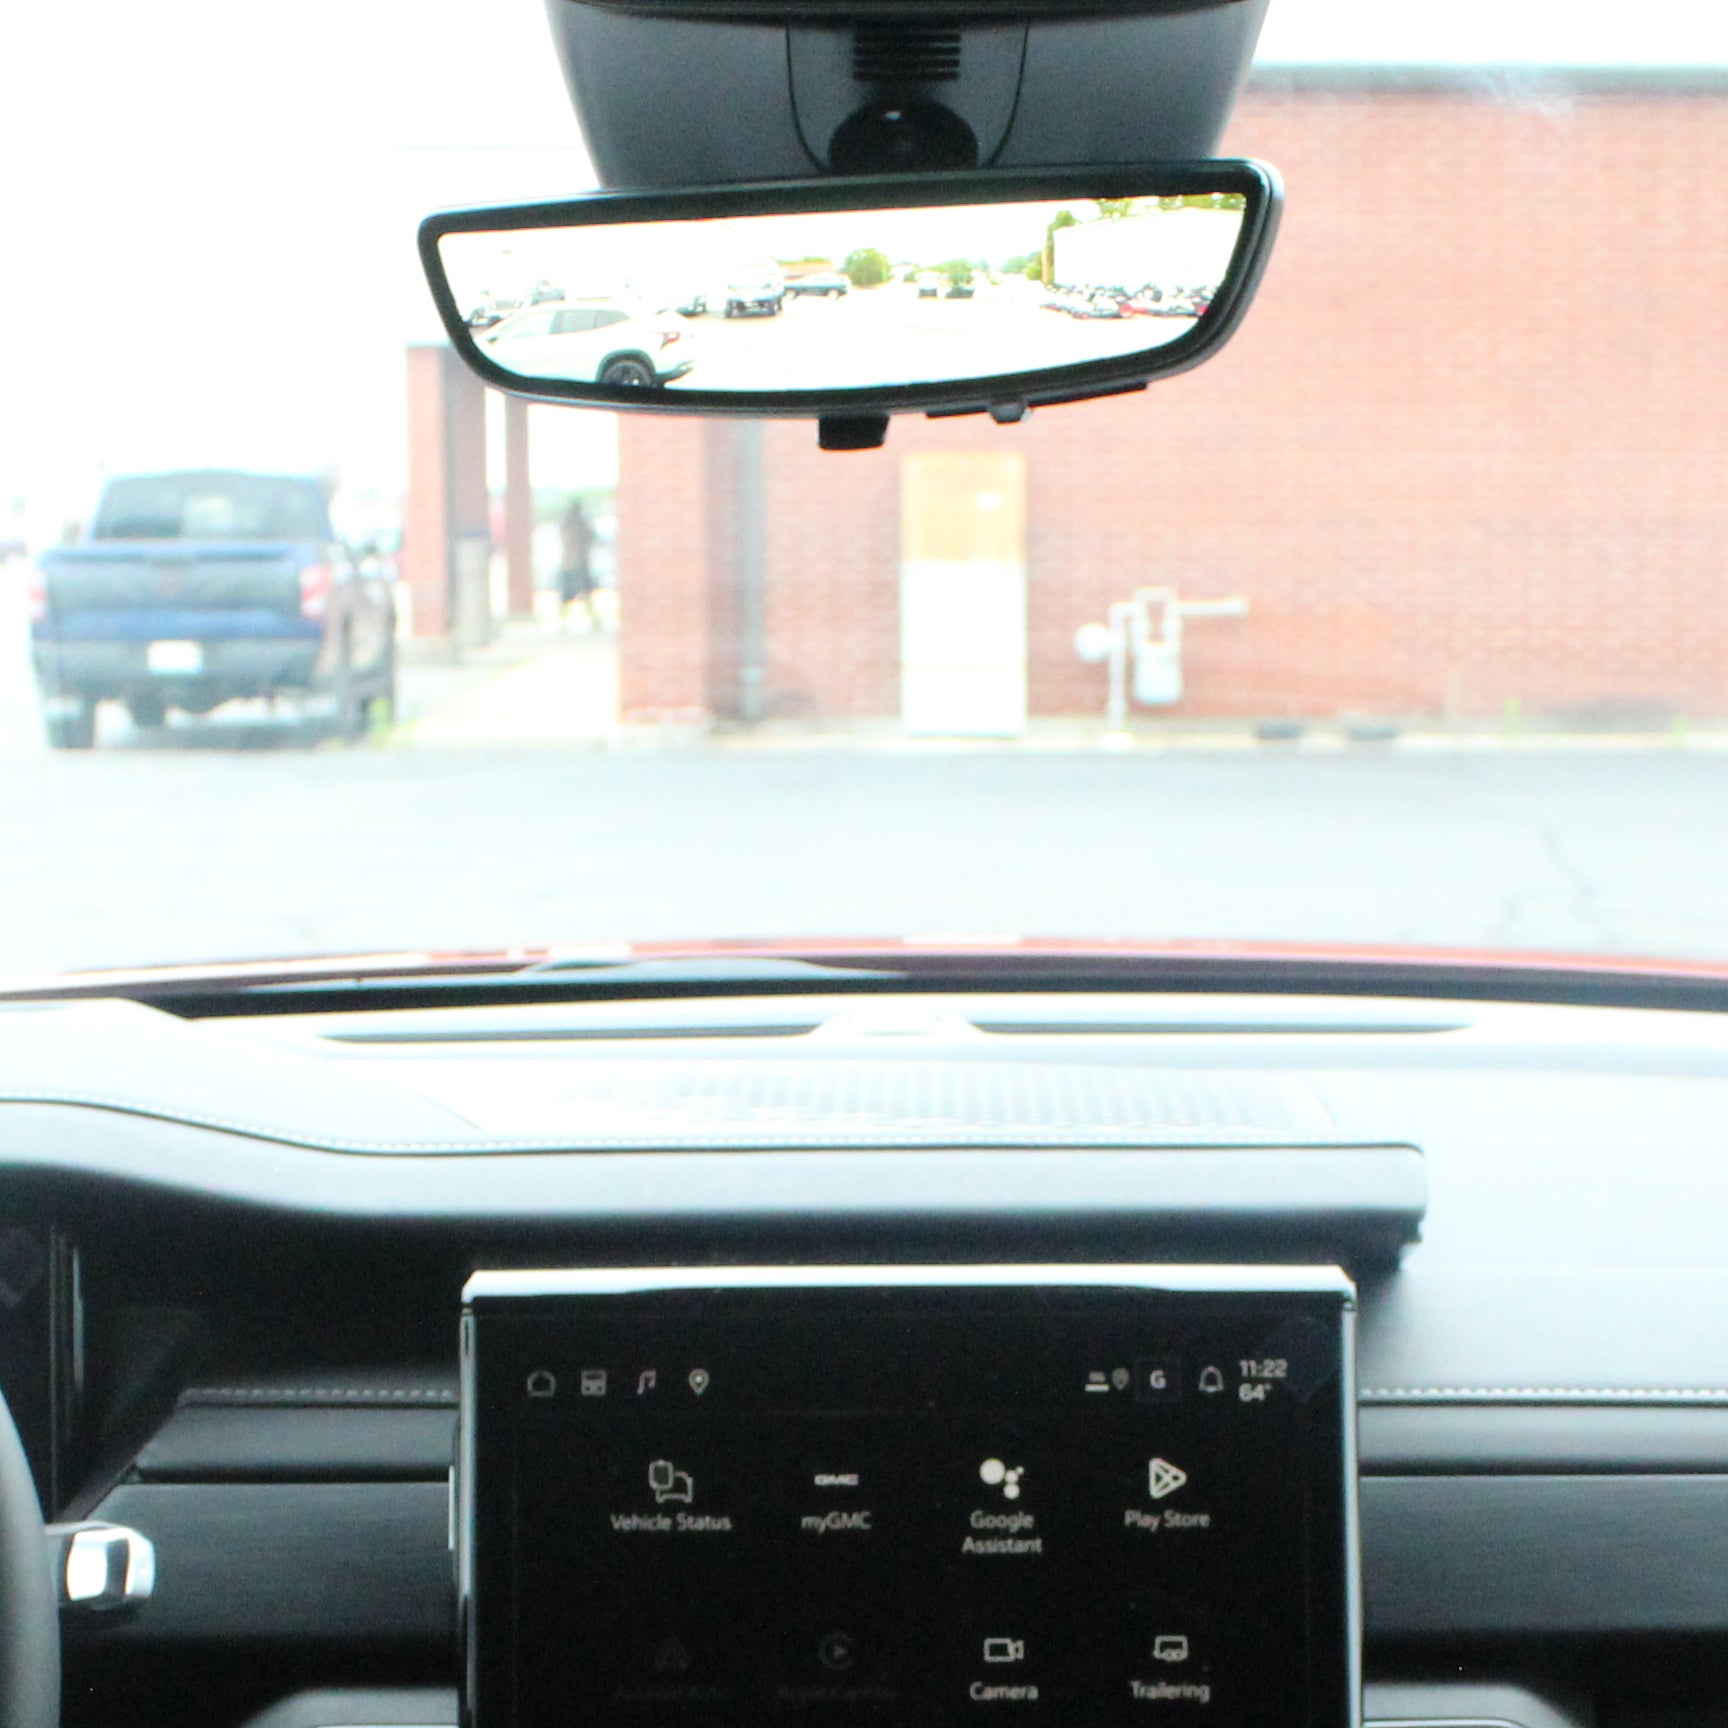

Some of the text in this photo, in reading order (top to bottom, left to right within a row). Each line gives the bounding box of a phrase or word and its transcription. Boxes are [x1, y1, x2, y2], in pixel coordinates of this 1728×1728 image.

[1240, 1359, 1288, 1378] 11:22
[611, 1513, 732, 1531] Vehicle Status
[801, 1511, 871, 1533] myGMC
[970, 1510, 1034, 1533] Google
[1125, 1510, 1210, 1532] Play Store
[962, 1536, 1042, 1554] Assistant
[970, 1682, 1038, 1700] Camera
[1131, 1680, 1210, 1703] Trailering
